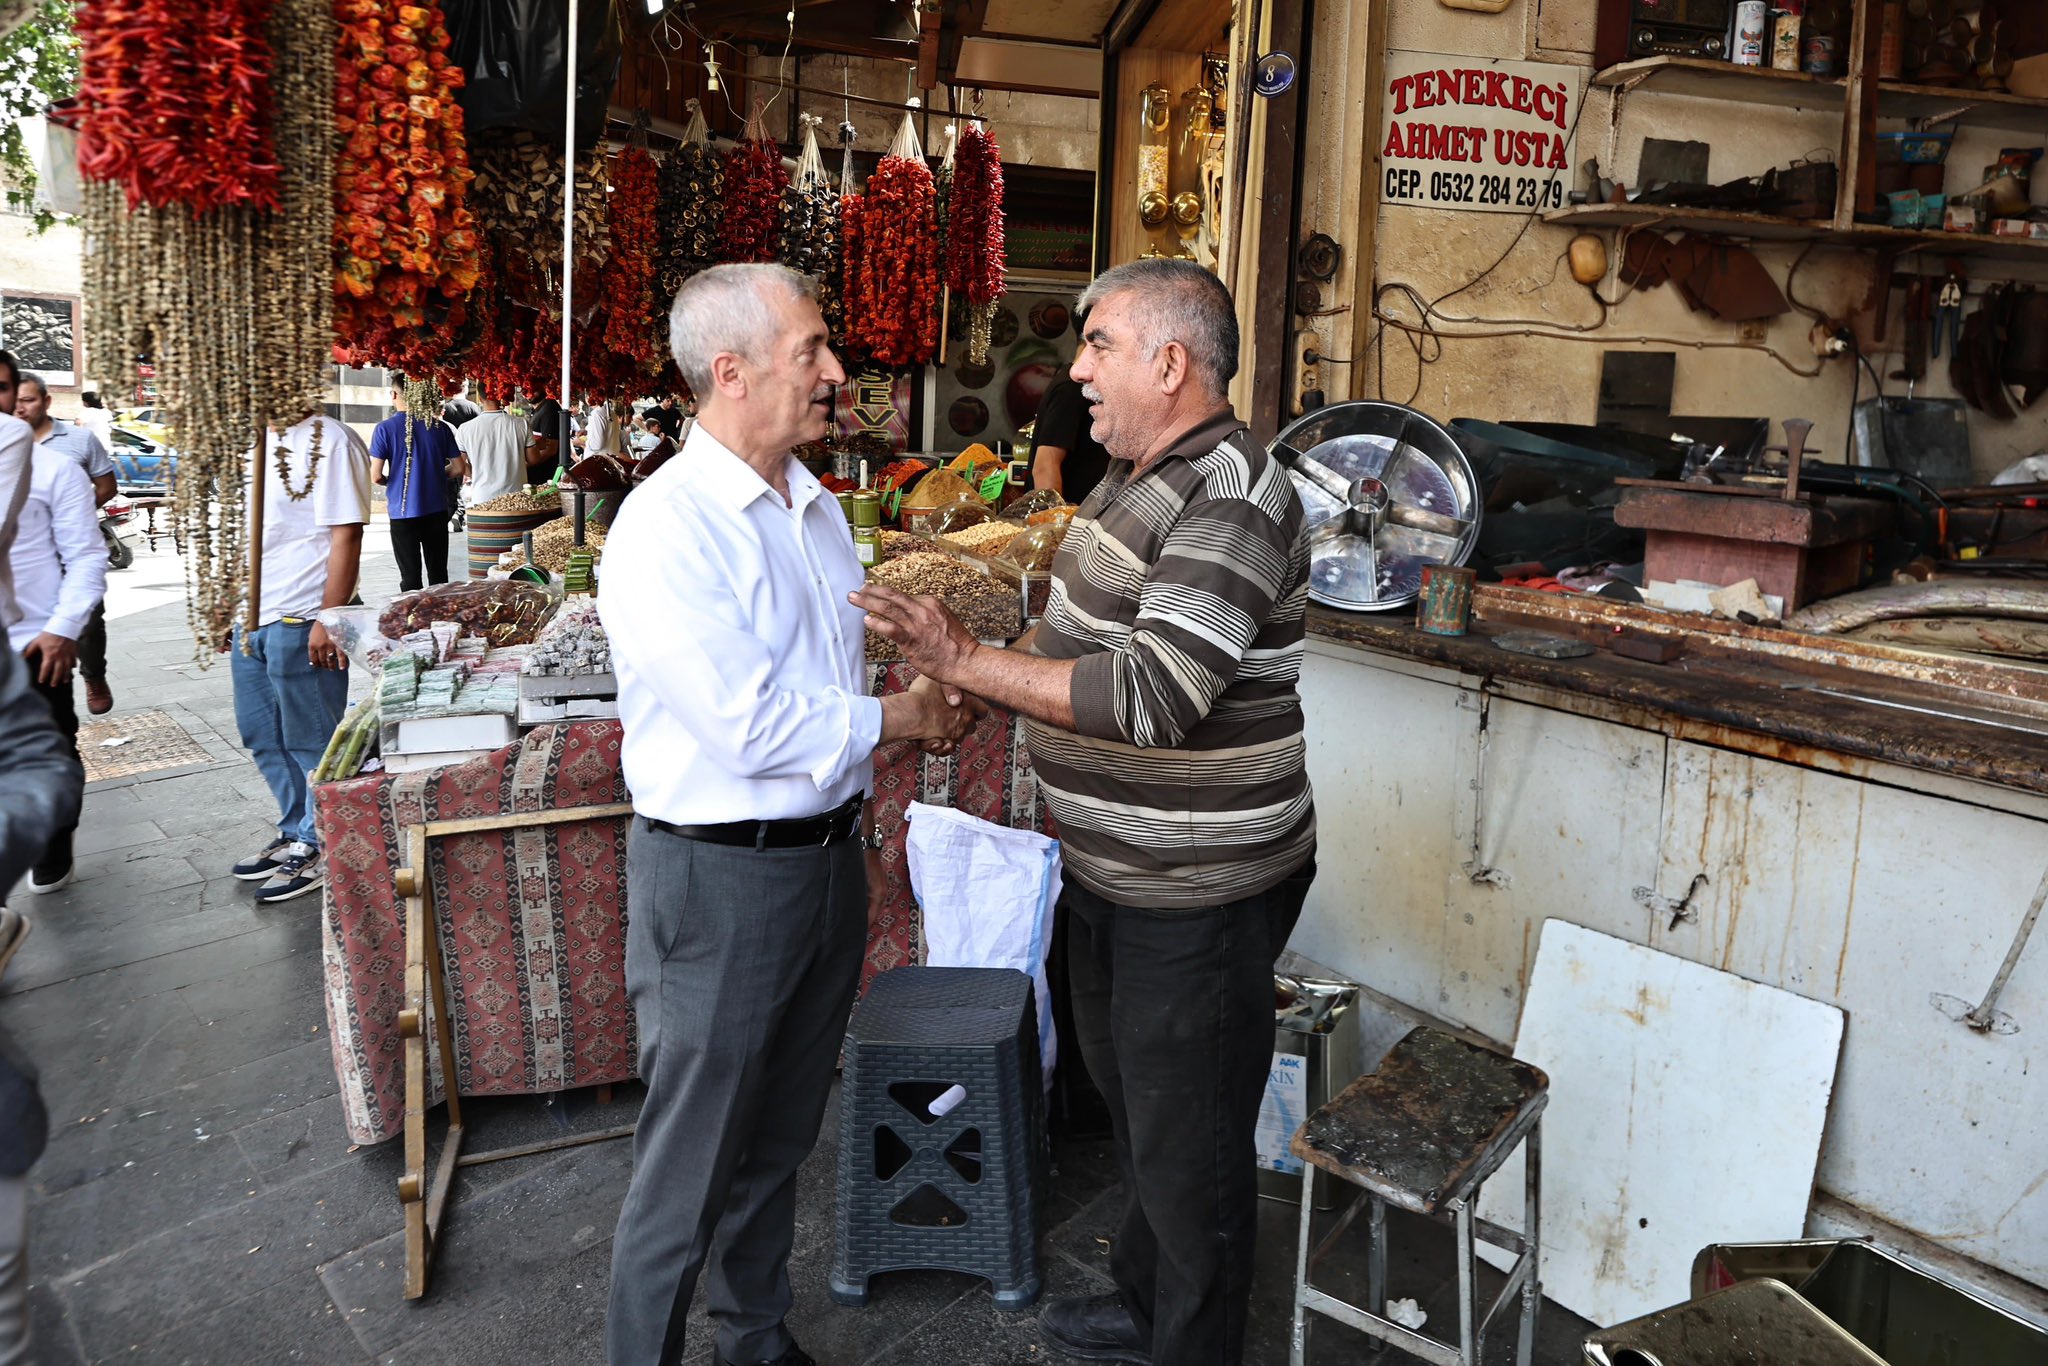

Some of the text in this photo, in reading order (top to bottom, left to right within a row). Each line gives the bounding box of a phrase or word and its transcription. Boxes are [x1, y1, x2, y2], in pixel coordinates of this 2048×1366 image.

[1265, 64, 1275, 83] 8
[1383, 120, 1568, 170] AHMET USTA
[1385, 167, 1563, 209] CEP. 0532 284 23 79
[1269, 1069, 1295, 1085] KİN
